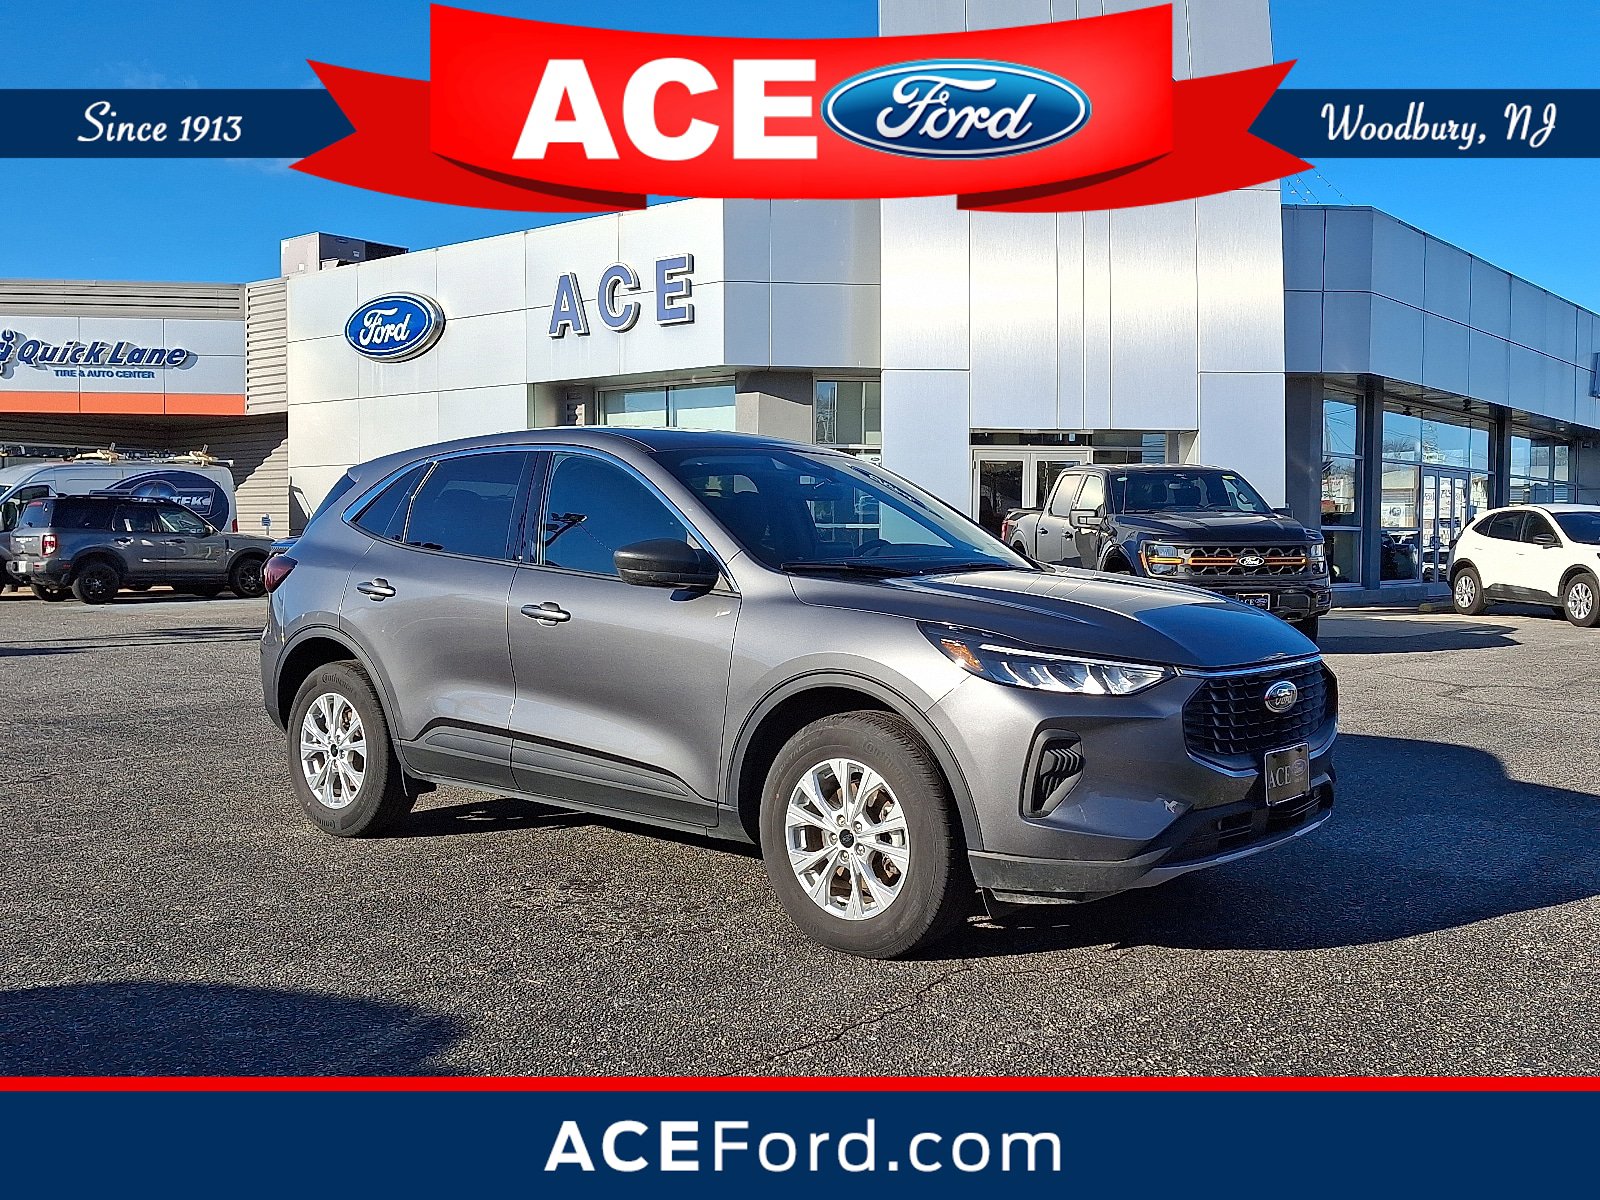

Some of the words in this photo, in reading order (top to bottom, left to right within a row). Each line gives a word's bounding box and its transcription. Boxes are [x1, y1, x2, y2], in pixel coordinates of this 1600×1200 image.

[548, 253, 694, 339] ACE
[358, 307, 411, 346] Ford
[17, 339, 106, 366] Quick
[107, 340, 188, 366] Lane
[54, 369, 78, 378] TIRE
[86, 369, 115, 379] AUTO
[115, 370, 155, 379] CENTER
[1268, 765, 1291, 790] ACE
